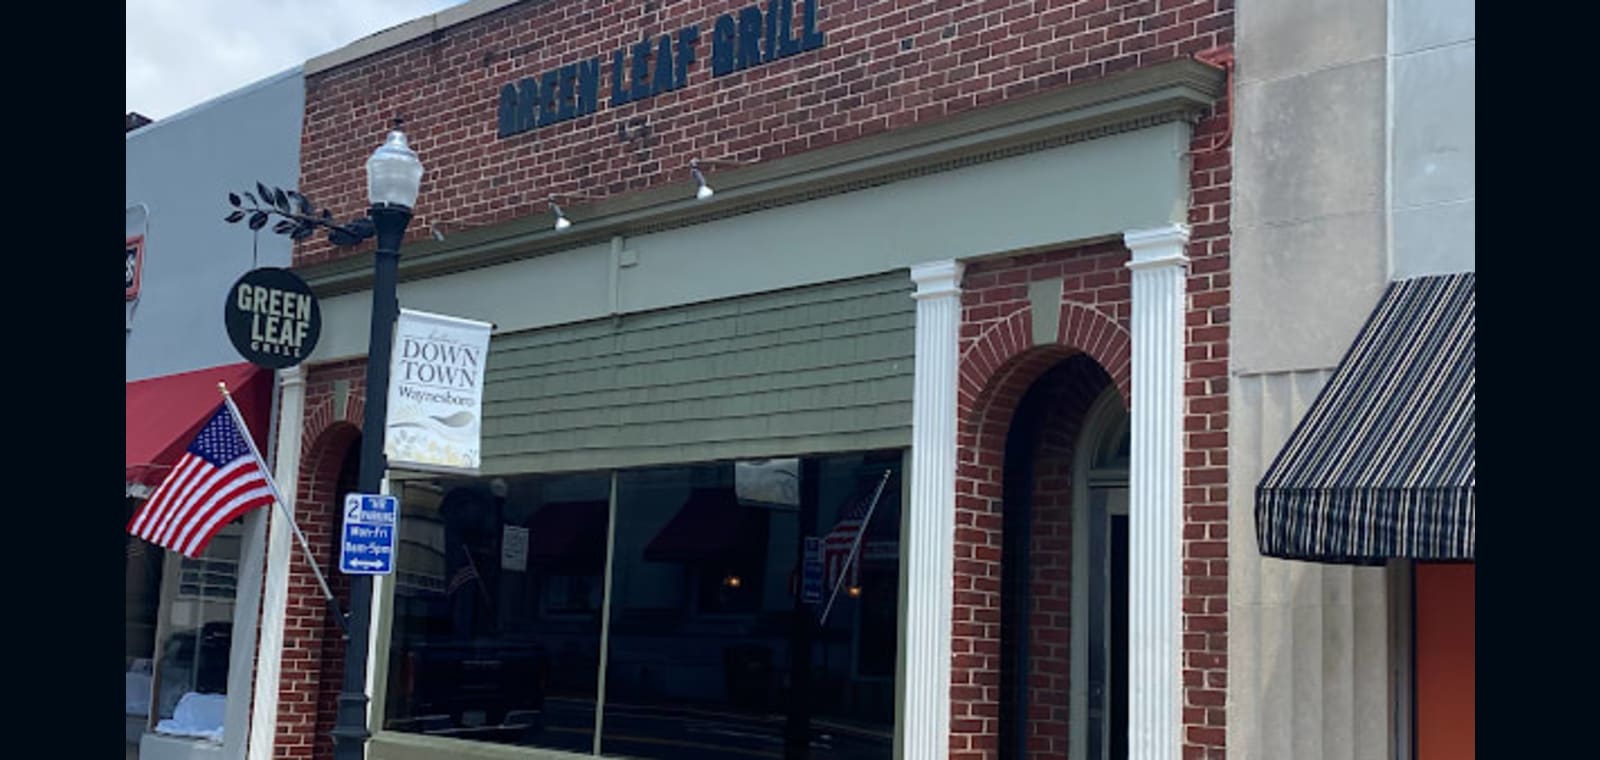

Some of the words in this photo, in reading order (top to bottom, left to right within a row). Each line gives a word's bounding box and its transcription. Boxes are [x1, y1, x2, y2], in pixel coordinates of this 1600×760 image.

[497, 57, 601, 138] GREEN
[611, 27, 702, 108] LEAF
[712, 0, 825, 78] GRILL
[238, 283, 311, 322] GREEN
[251, 314, 310, 347] LEAF
[250, 341, 301, 358] GRILL
[402, 338, 480, 367] DOWN
[400, 360, 478, 388] TOWN
[398, 385, 475, 407] Waynesboro
[348, 497, 359, 519] 2
